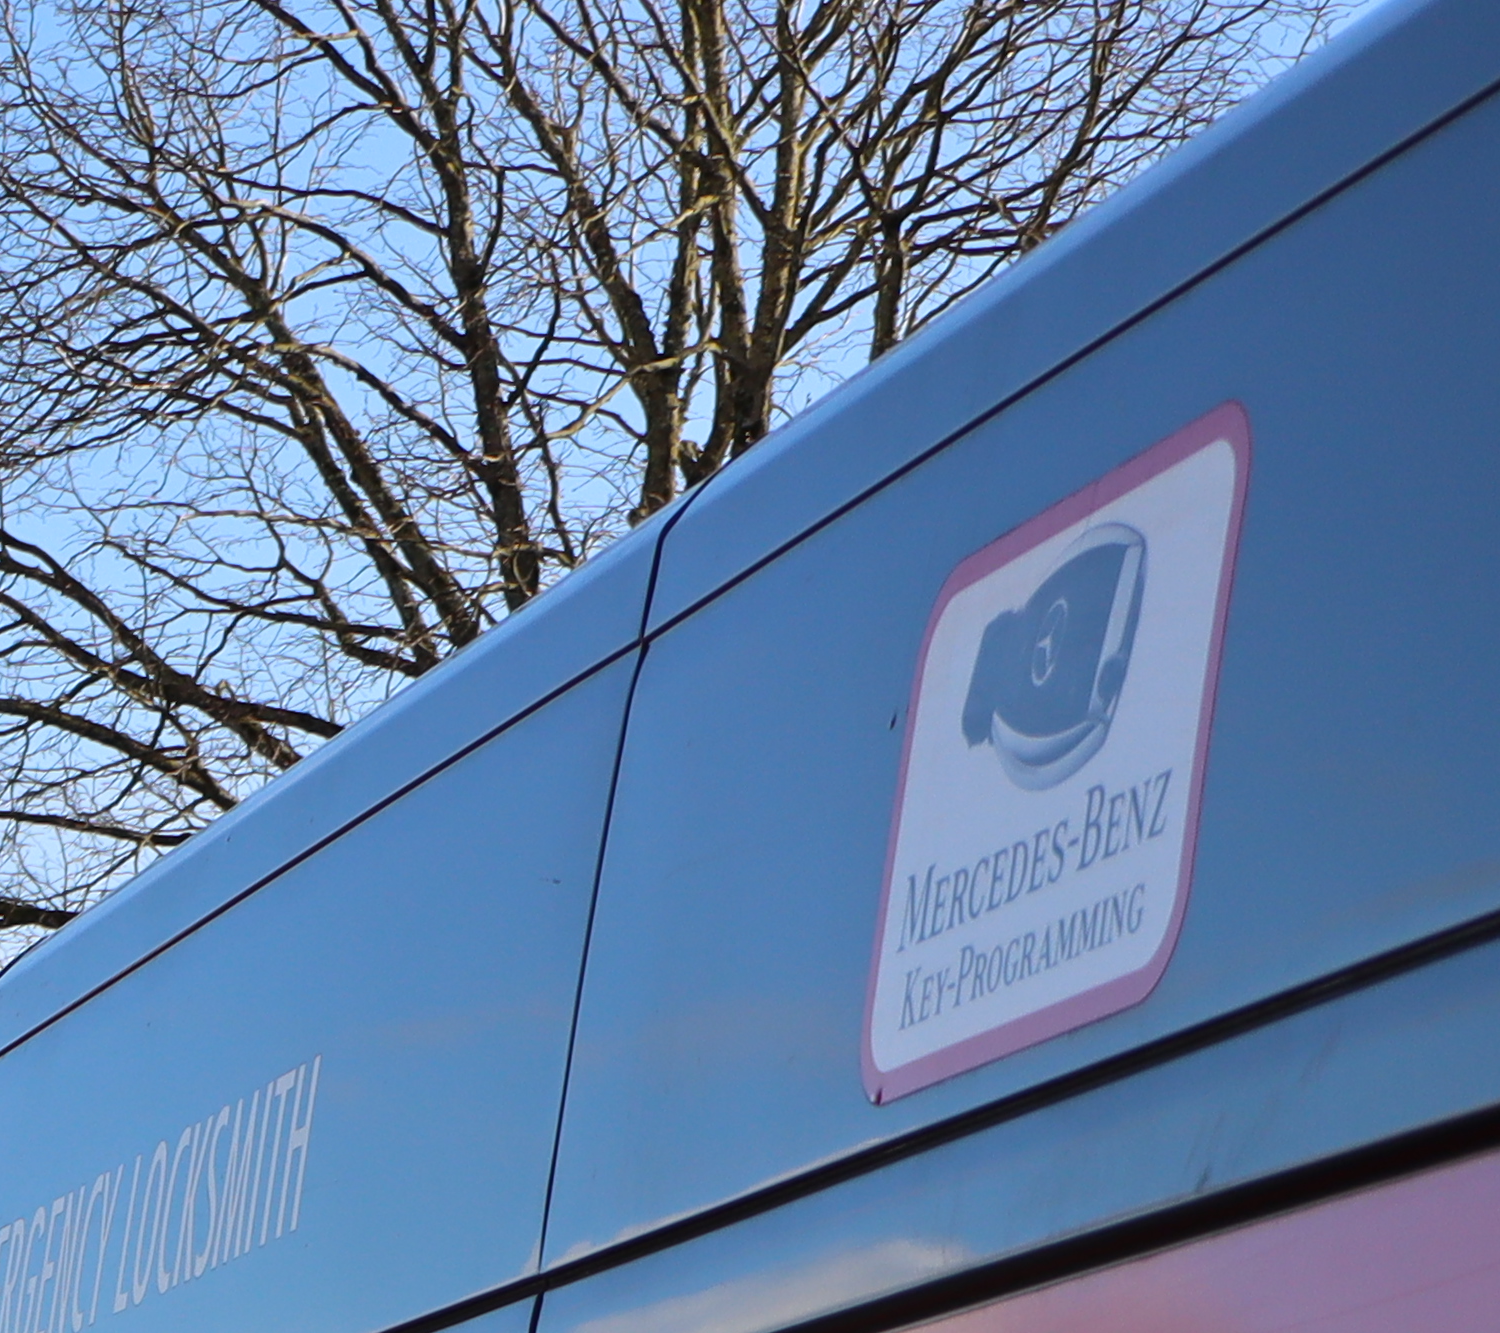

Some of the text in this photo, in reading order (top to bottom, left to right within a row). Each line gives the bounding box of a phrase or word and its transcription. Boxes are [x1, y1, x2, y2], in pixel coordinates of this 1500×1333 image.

[896, 767, 1173, 954] MERCEDES-BENZ
[898, 883, 1146, 1031] KEY-PROGRAMMING
[113, 1054, 323, 1315] LOCKSMITH
